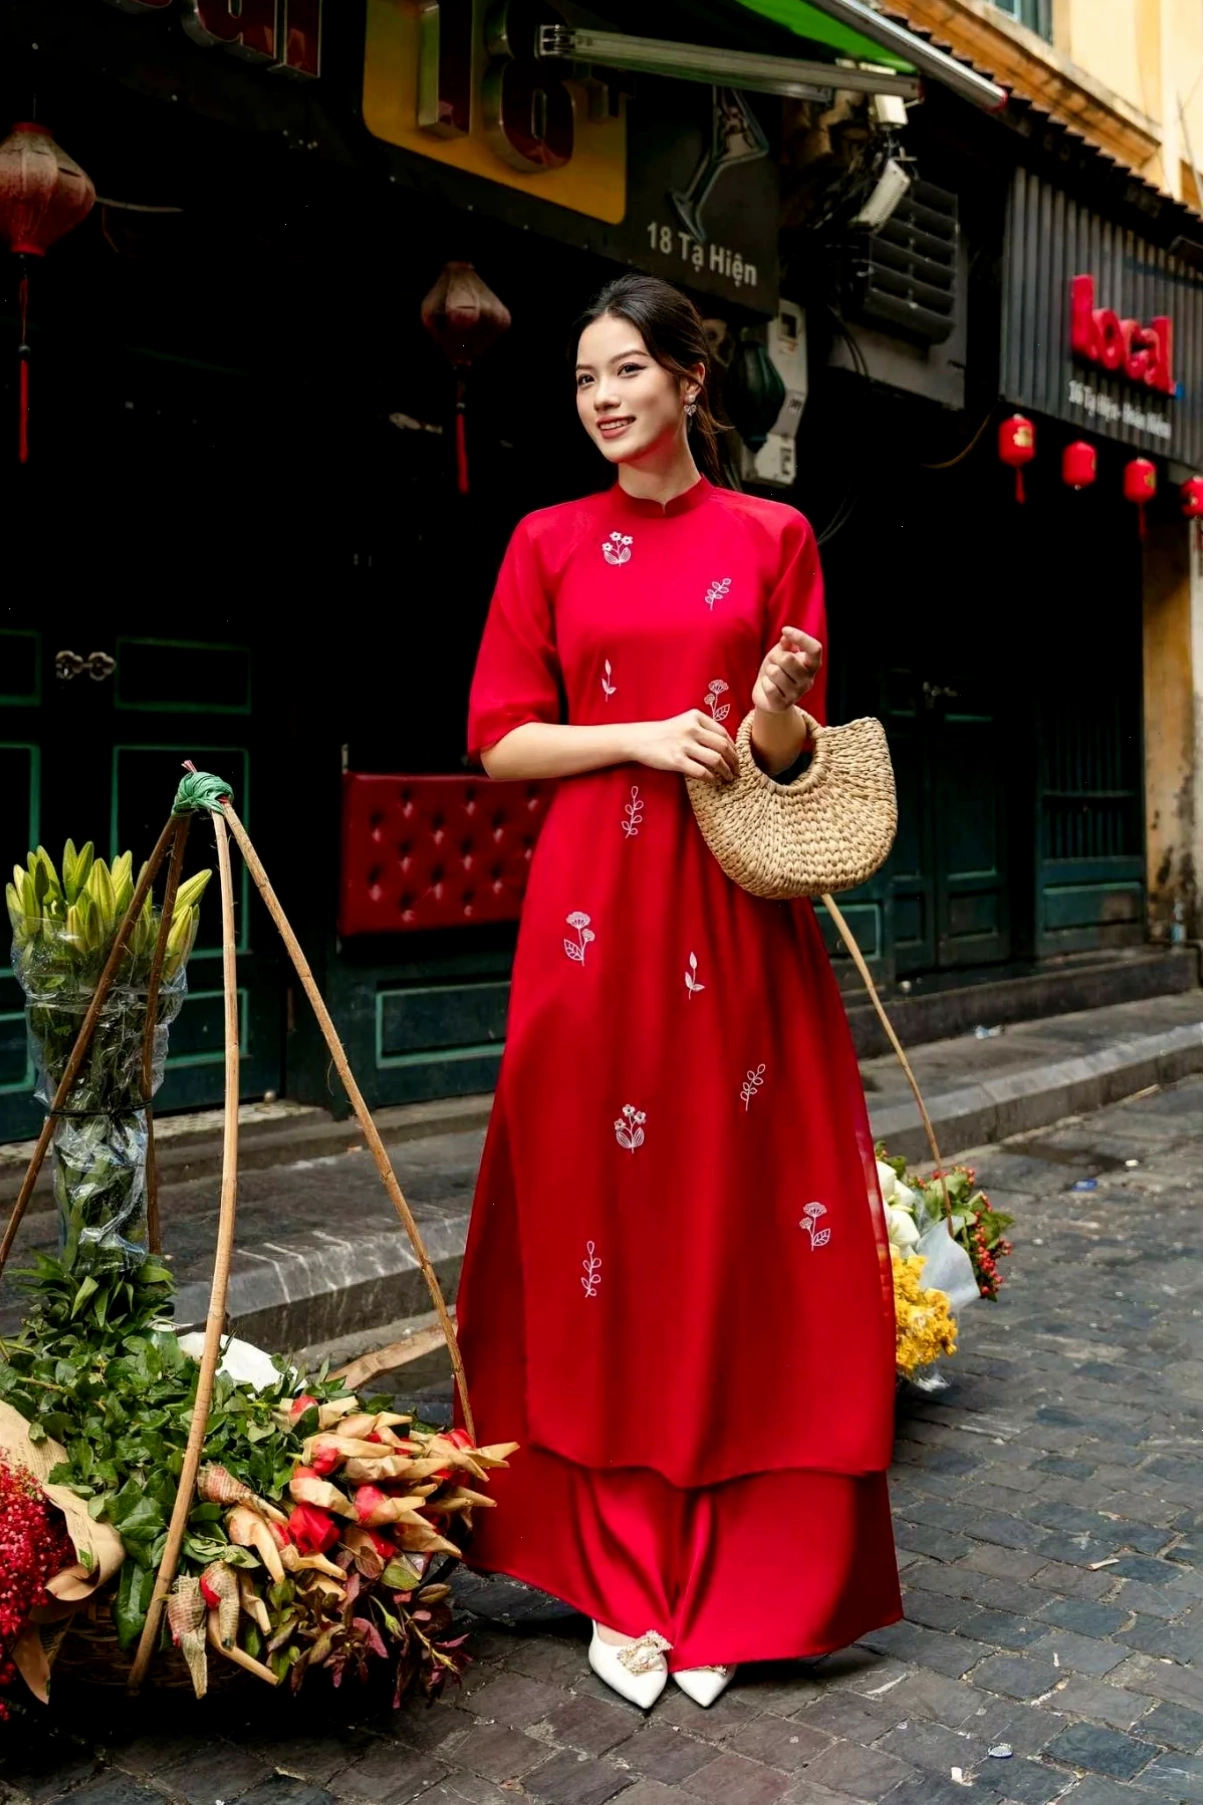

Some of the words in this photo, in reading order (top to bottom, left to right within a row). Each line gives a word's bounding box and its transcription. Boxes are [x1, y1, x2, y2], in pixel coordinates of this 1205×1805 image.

[647, 221, 672, 255] 18
[678, 231, 705, 274] Tạ
[709, 243, 758, 288] Hiện
